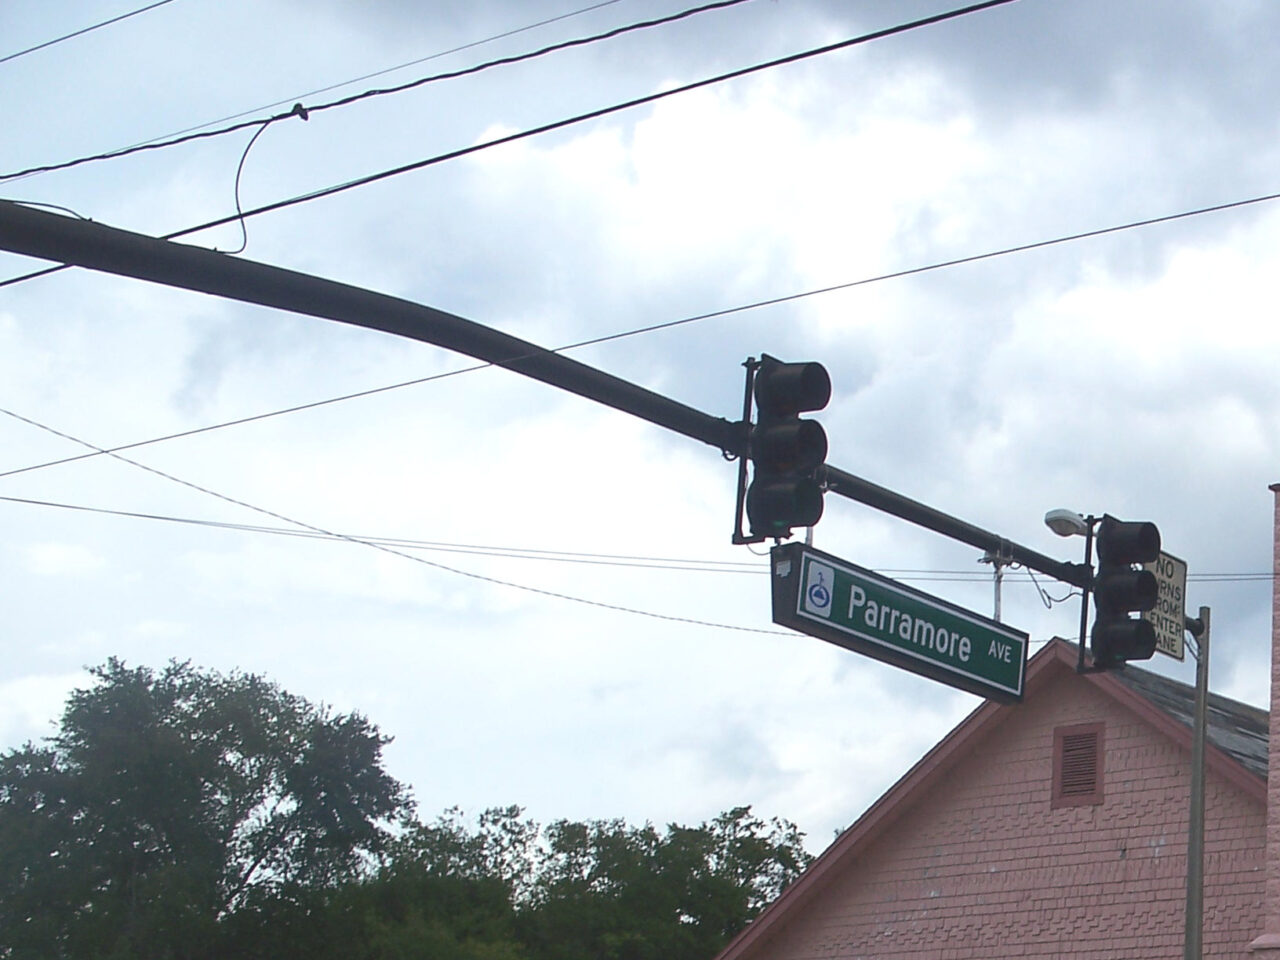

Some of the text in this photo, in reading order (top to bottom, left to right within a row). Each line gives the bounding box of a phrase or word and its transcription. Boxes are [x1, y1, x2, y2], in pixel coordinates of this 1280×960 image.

[1156, 557, 1175, 579] NO
[1158, 580, 1182, 602] RNS
[1156, 597, 1179, 617] ROM
[848, 584, 1012, 663] Parramore AVE
[1150, 612, 1182, 637] ENTER
[1156, 632, 1177, 653] ANE
